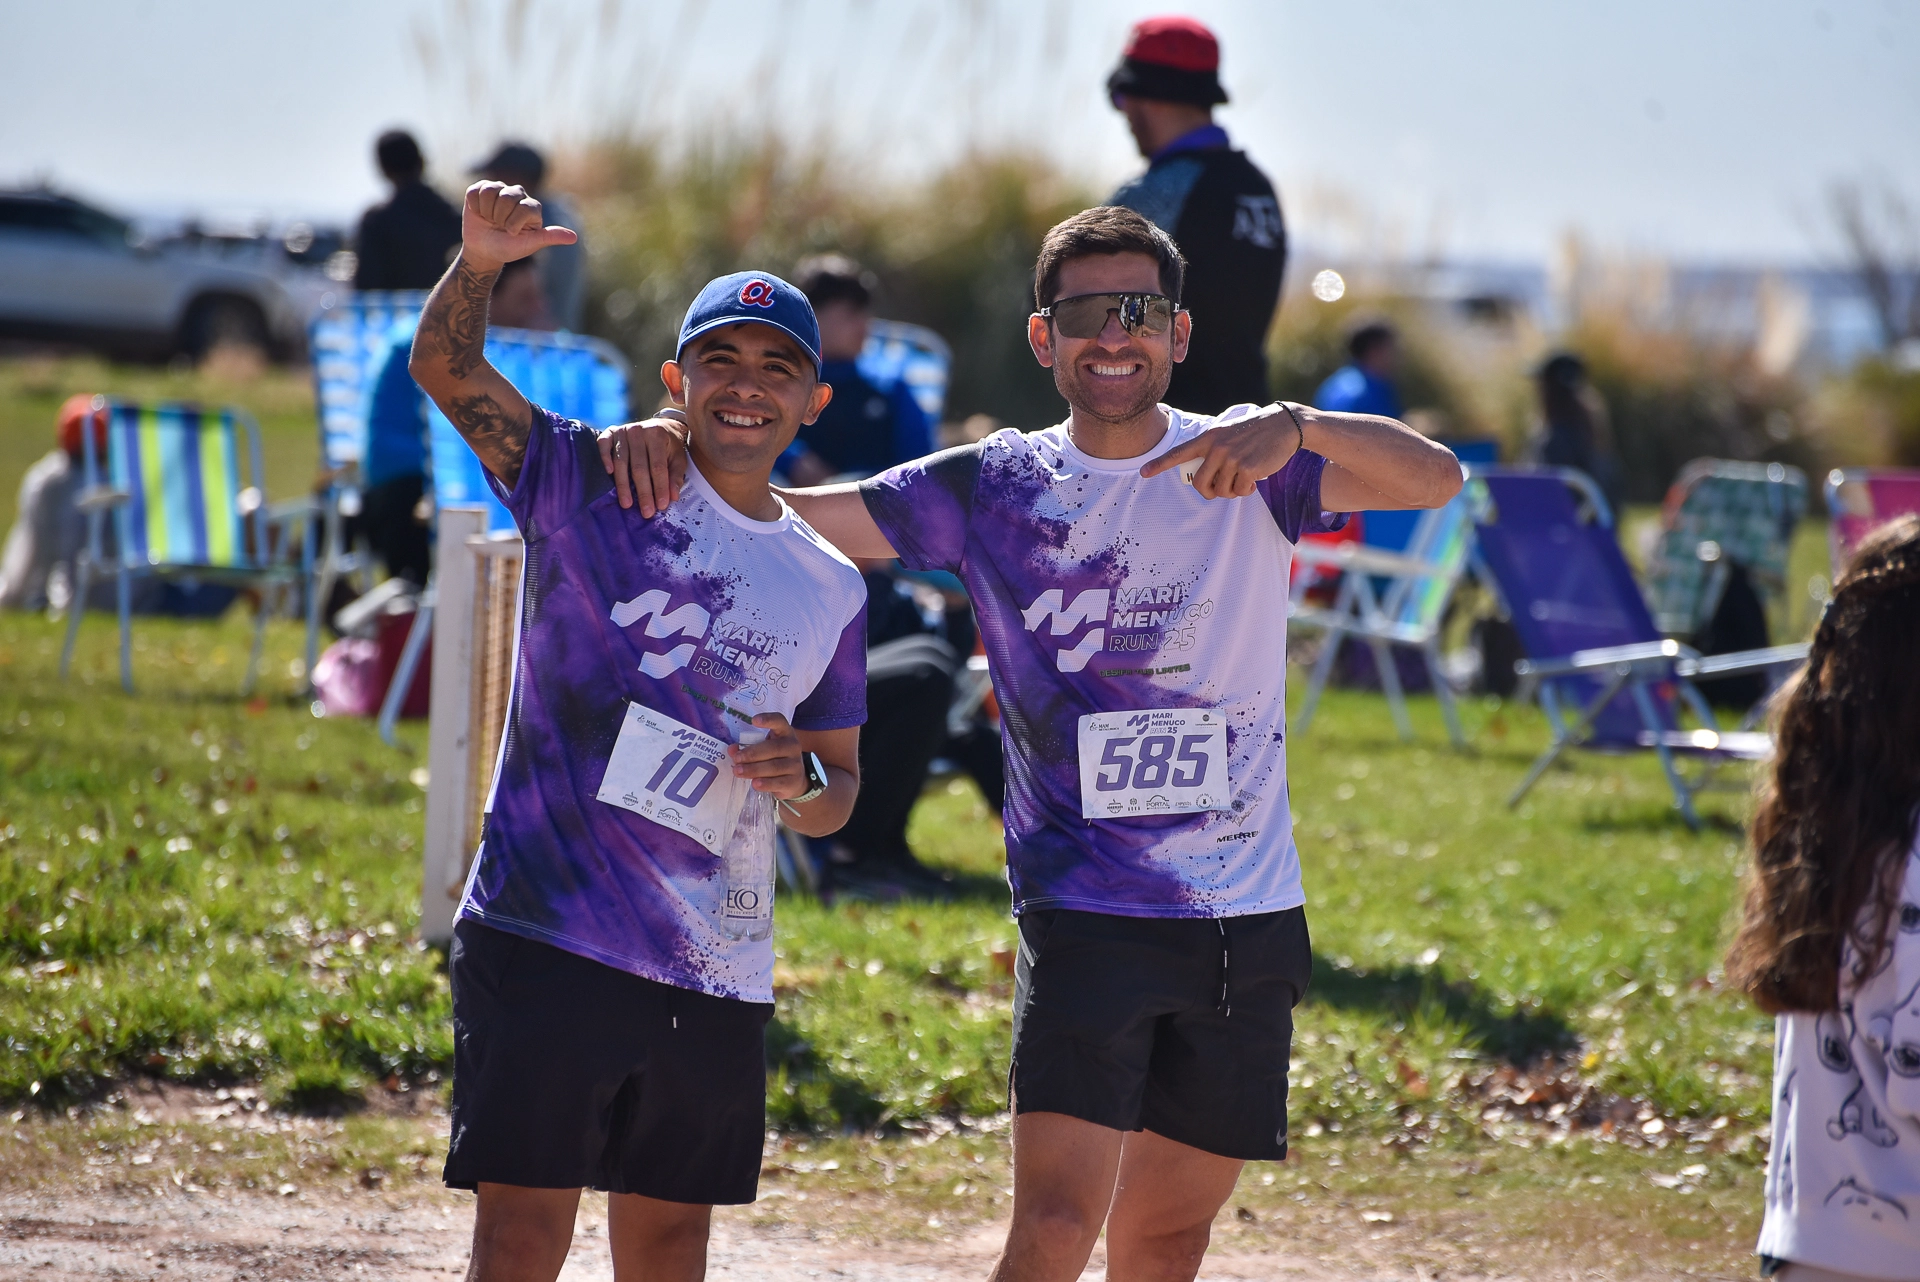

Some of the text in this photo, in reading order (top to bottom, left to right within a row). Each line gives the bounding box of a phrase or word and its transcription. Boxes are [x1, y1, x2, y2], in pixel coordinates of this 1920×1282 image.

[1115, 585, 1181, 605] MARI
[1111, 600, 1214, 629] MENUCO
[711, 617, 777, 654] MARI
[1109, 626, 1197, 652] RUN 25
[703, 636, 791, 693] MENUCO
[693, 655, 769, 706] RUN 25
[1151, 712, 1173, 720] MARI
[1151, 719, 1186, 727] MENUCO
[697, 735, 719, 748] MARI
[1167, 726, 1178, 735] 25
[693, 742, 726, 760] MENUCO
[706, 754, 718, 764] 25
[1095, 734, 1214, 792] 585
[644, 748, 720, 808] 10
[726, 888, 759, 912] ECO
